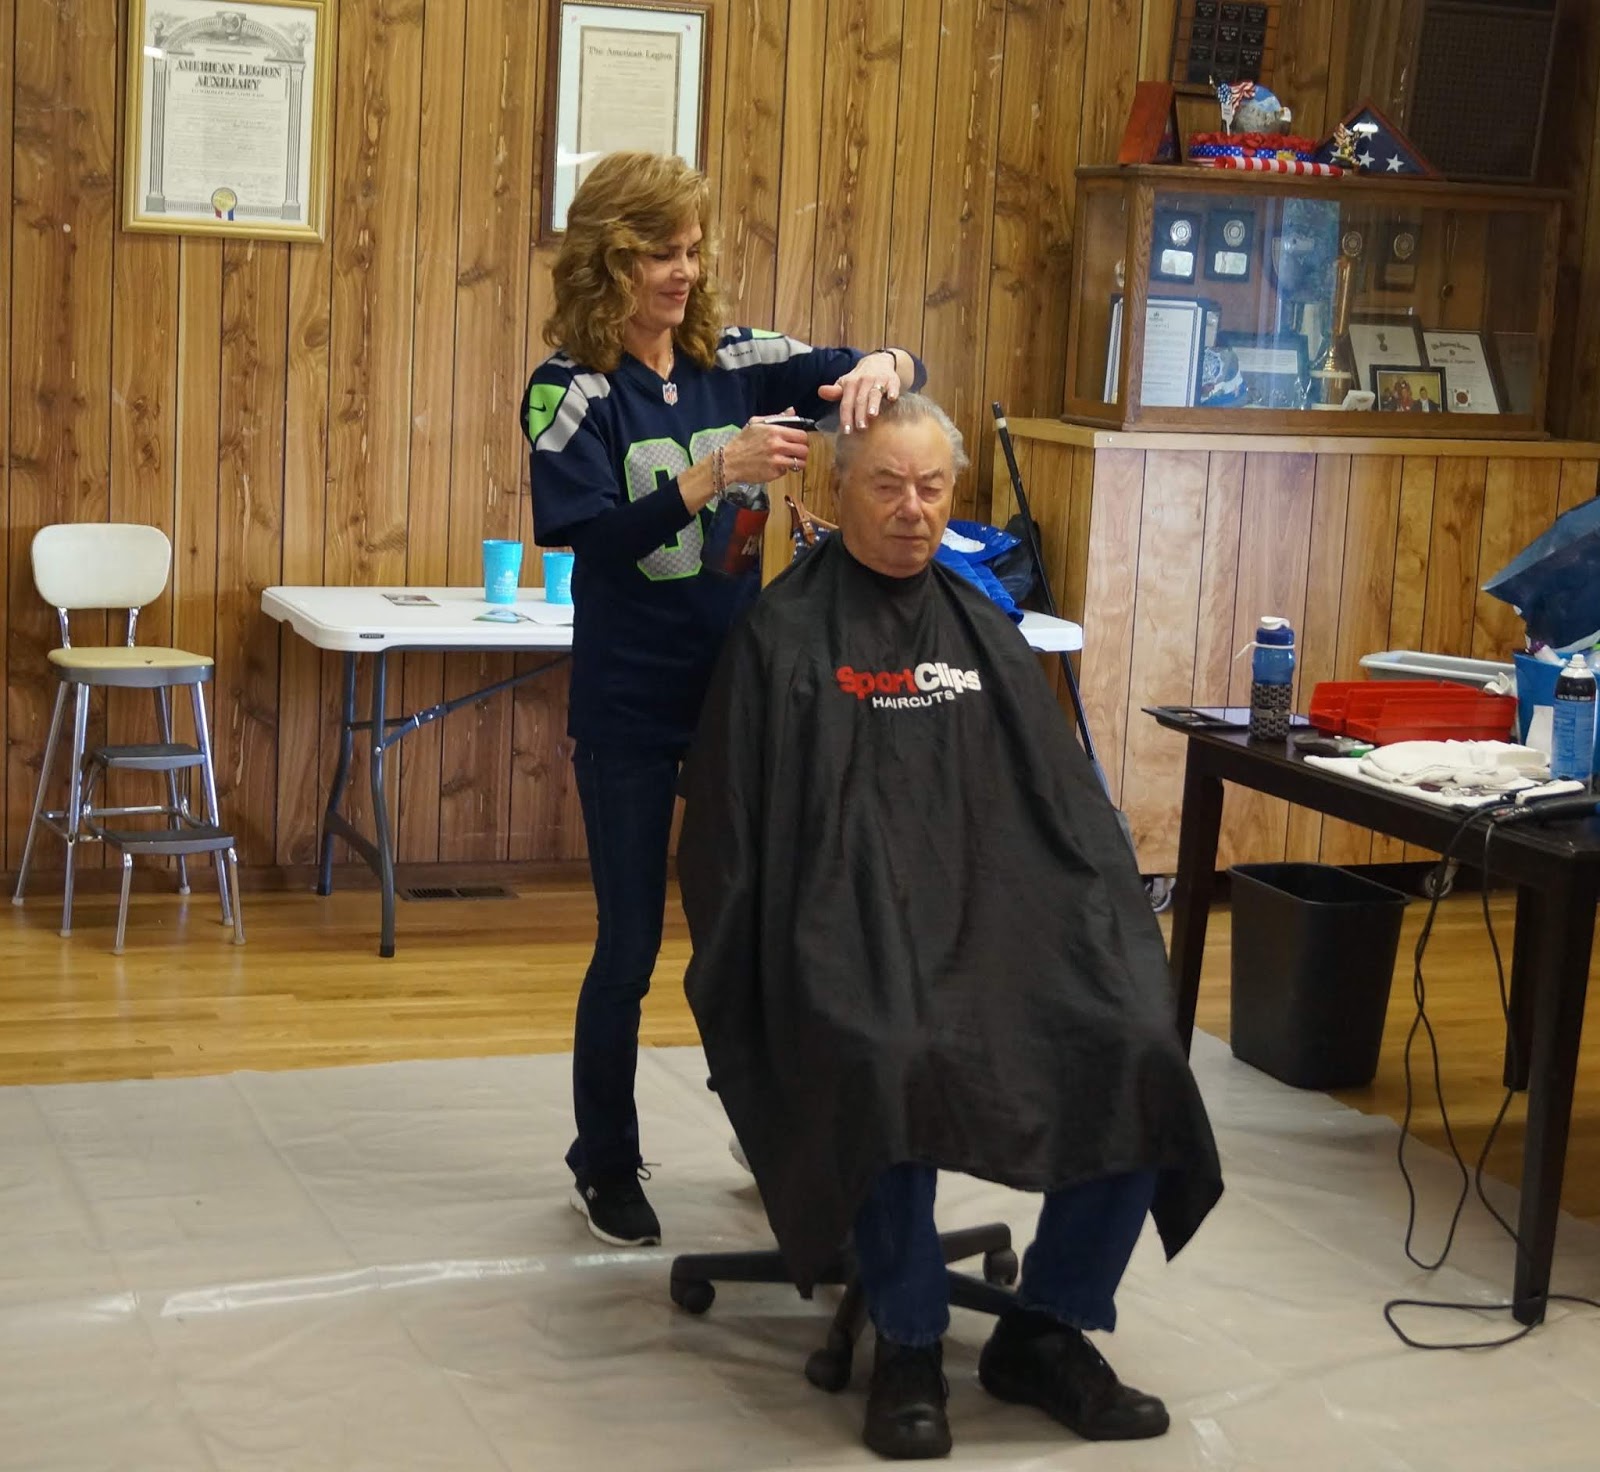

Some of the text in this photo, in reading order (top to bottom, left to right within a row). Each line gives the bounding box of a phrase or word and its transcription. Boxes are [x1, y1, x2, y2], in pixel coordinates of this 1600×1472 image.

[607, 47, 643, 58] American
[645, 50, 673, 61] Legion
[176, 60, 282, 77] AMERICAN LEGION
[196, 75, 262, 90] AUXILIARY
[836, 662, 982, 699] SportClips
[872, 690, 956, 709] HAIRCUTS
